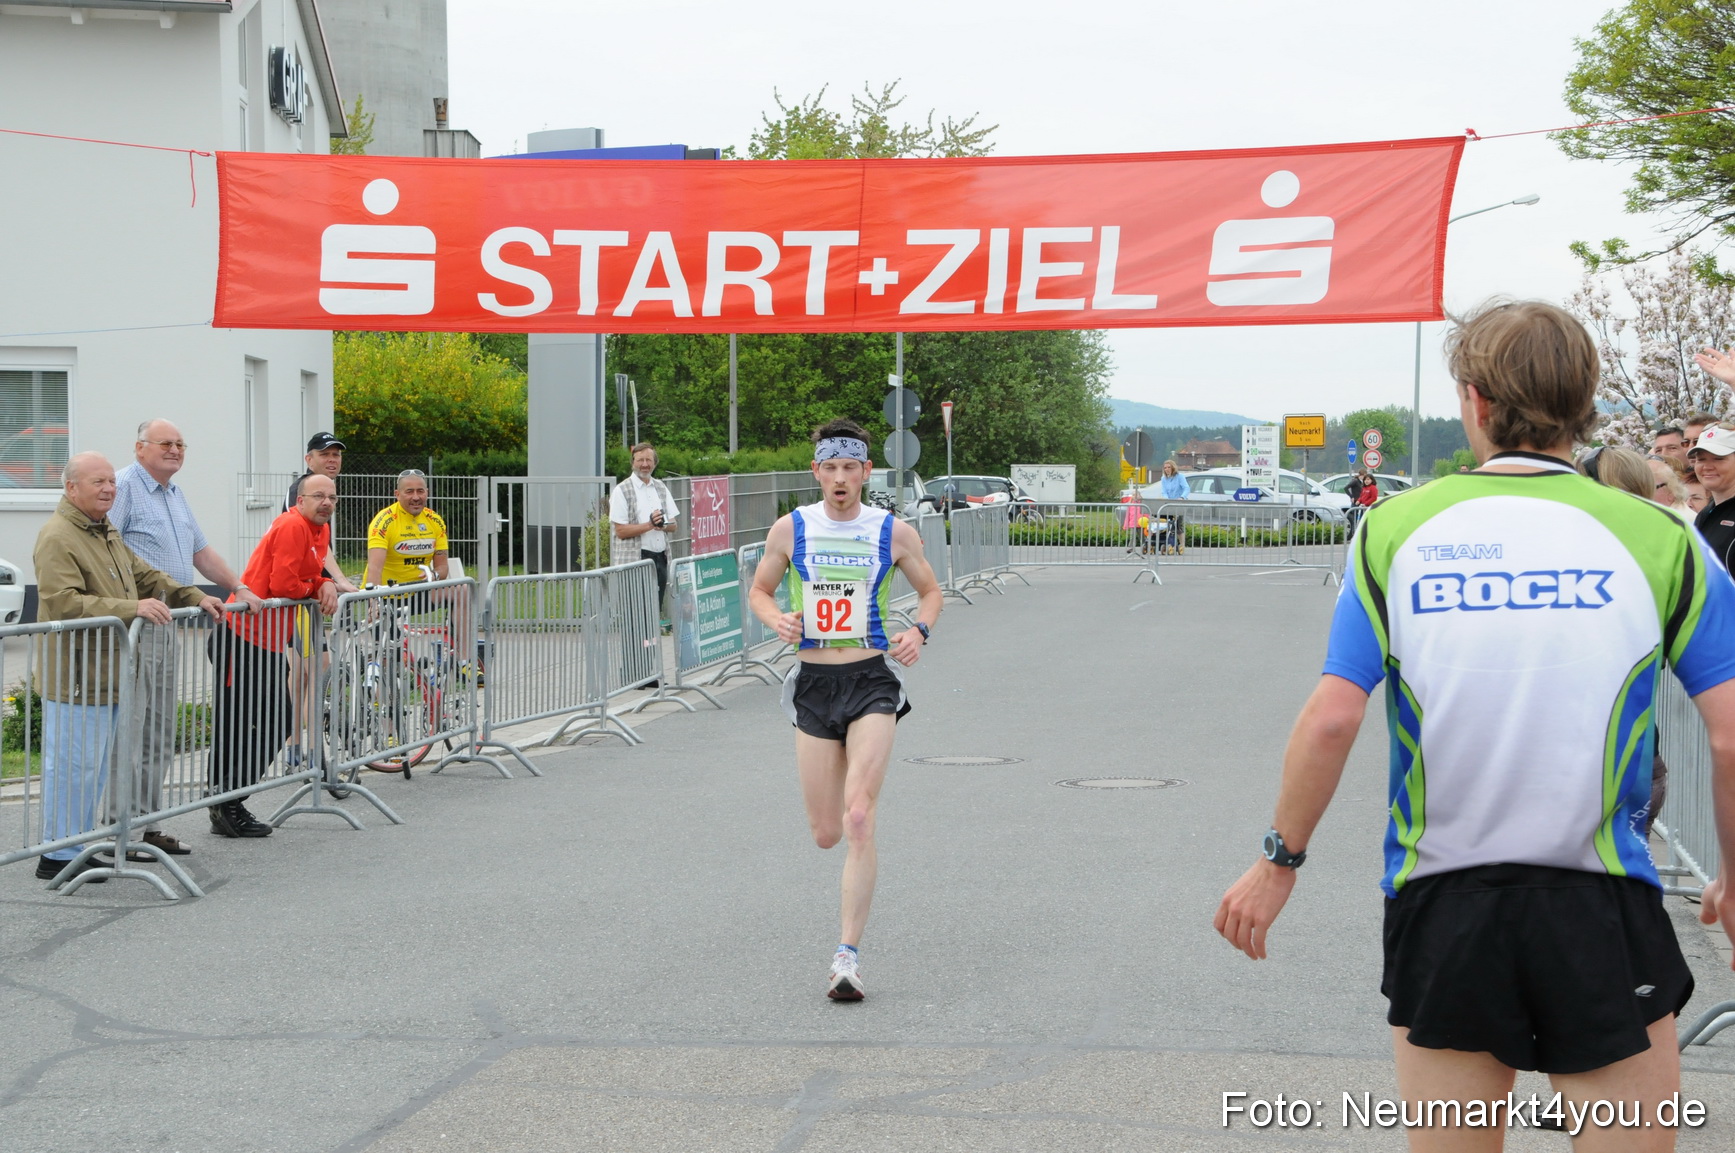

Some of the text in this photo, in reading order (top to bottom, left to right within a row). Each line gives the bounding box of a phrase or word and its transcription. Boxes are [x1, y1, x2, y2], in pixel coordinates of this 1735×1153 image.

[278, 46, 308, 125] GRAF
[1289, 427, 1321, 435] Neumarkt
[1367, 434, 1378, 444] 60
[698, 514, 726, 539] ZEITLOS
[396, 542, 432, 551] Mercatone
[1418, 544, 1502, 561] TEAM
[812, 554, 874, 567] BOCK
[1411, 569, 1615, 614] BOCK
[816, 598, 852, 633] 92
